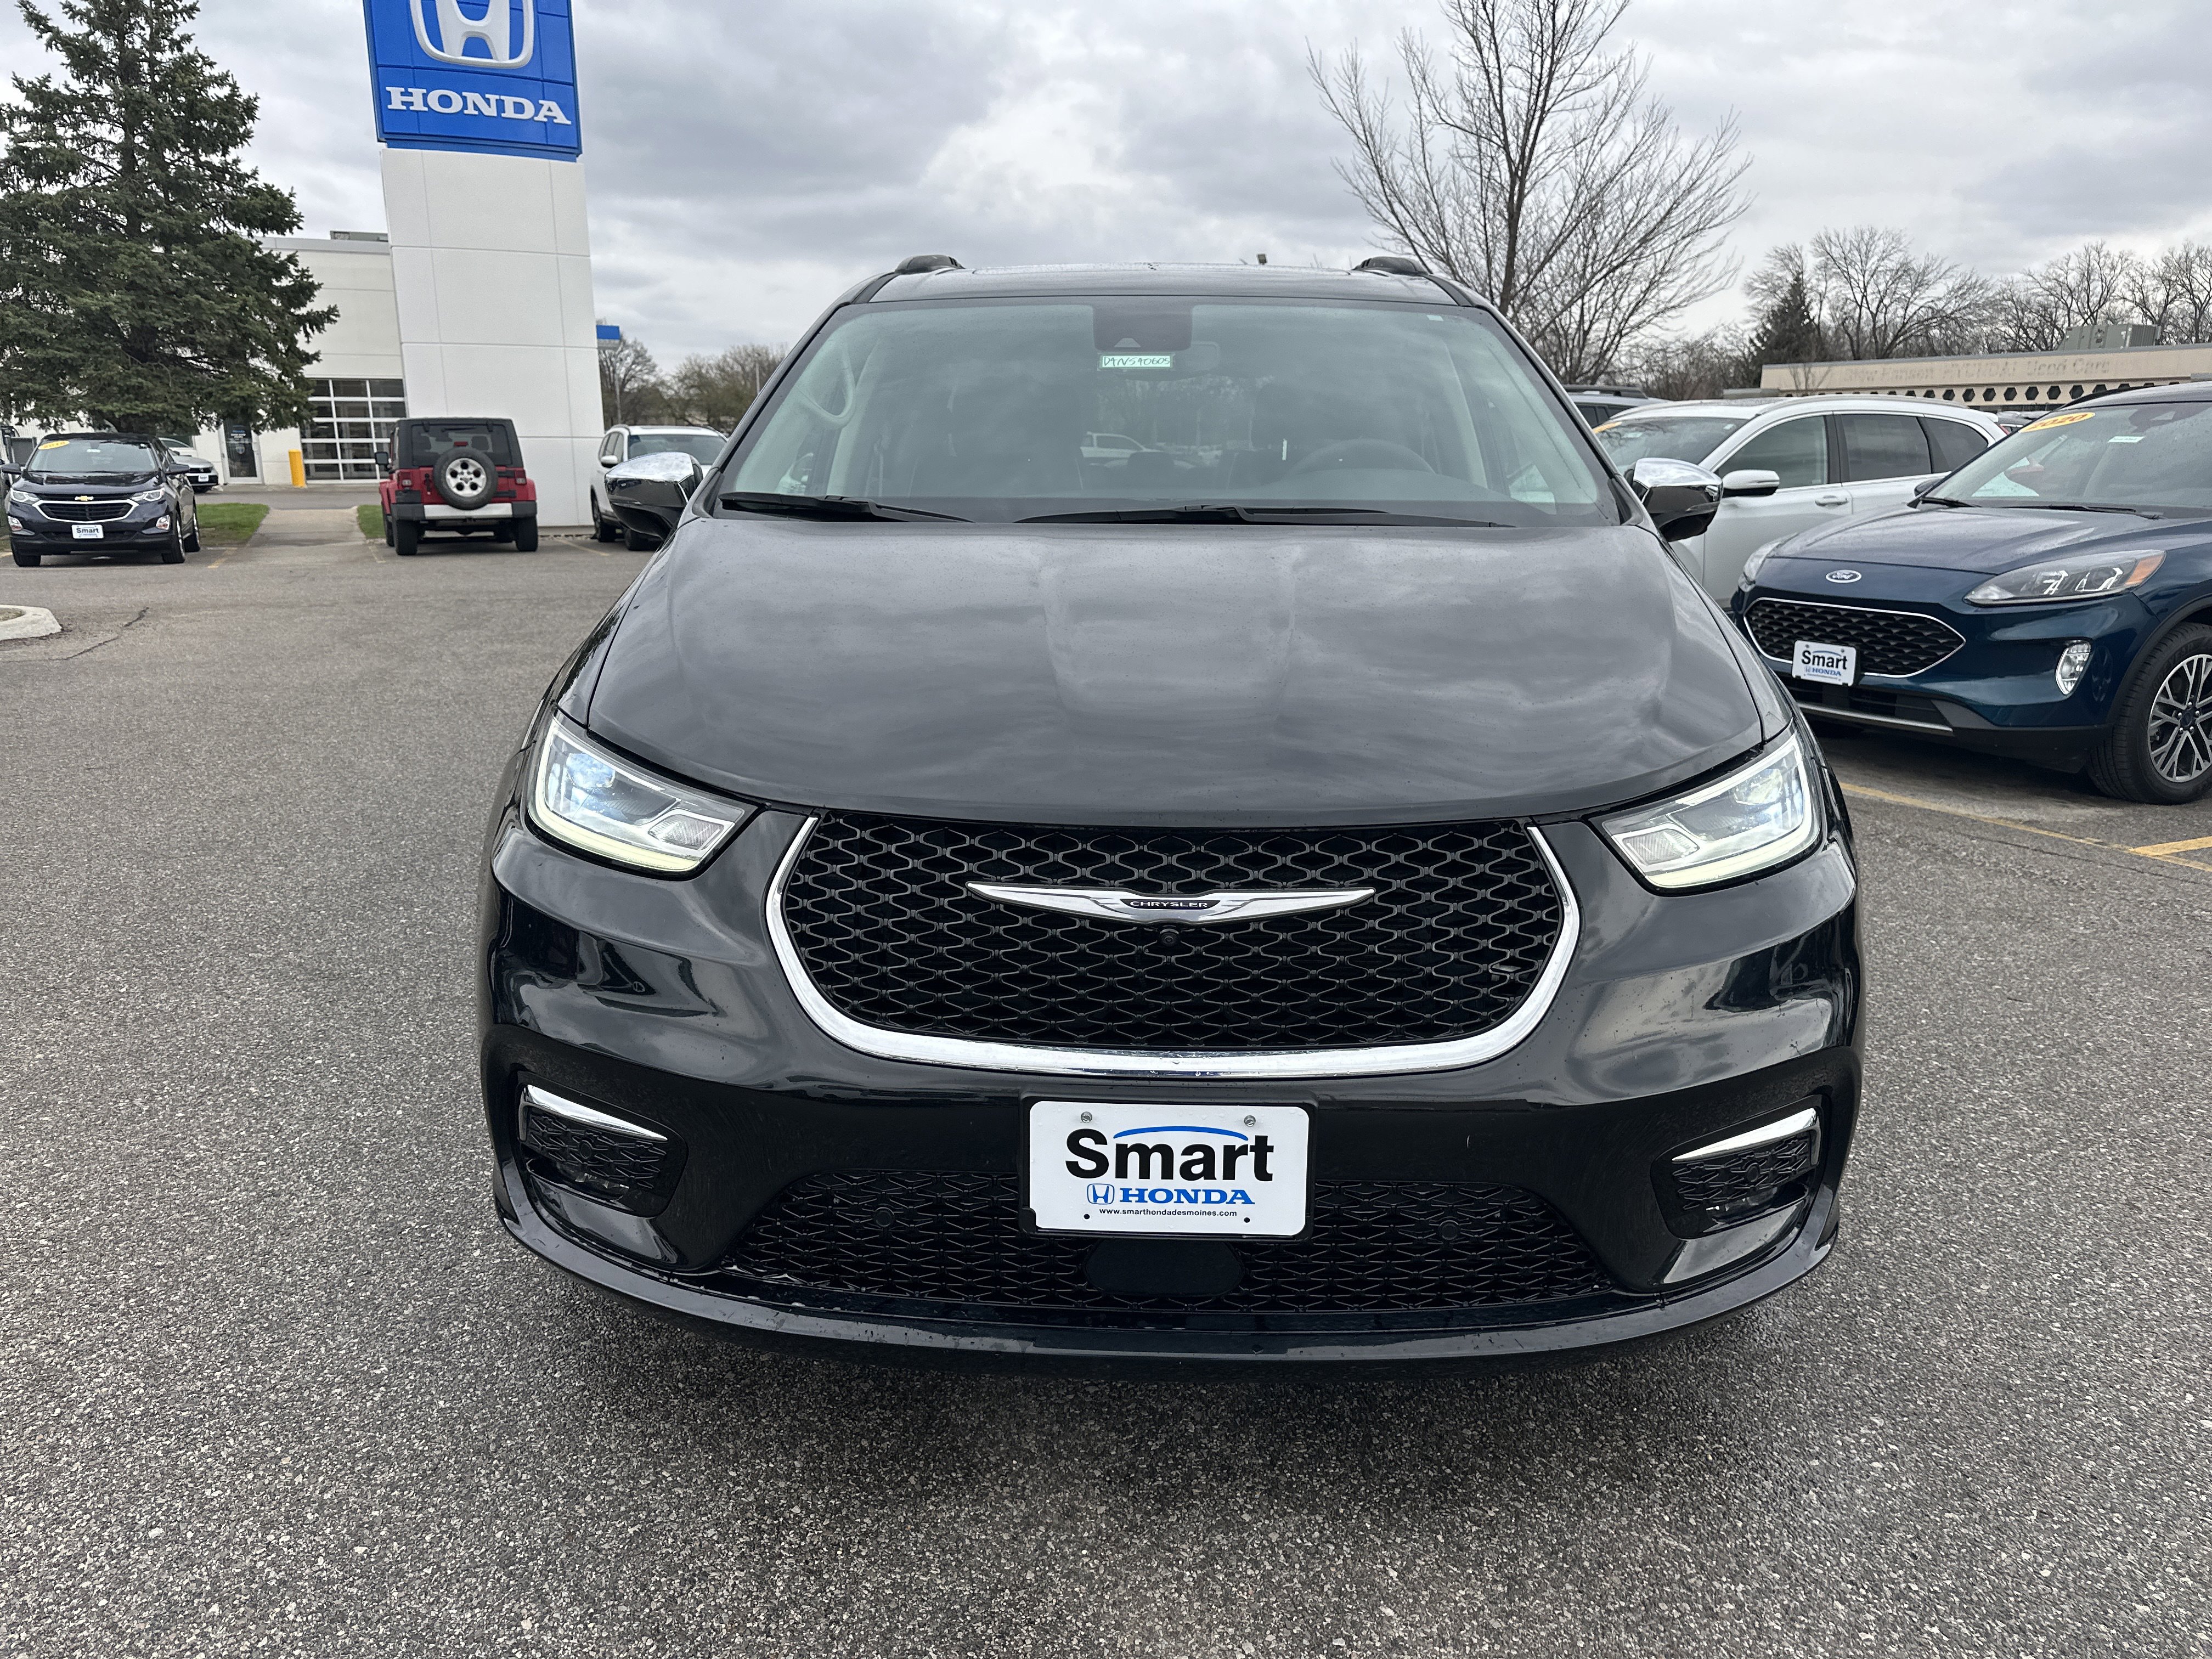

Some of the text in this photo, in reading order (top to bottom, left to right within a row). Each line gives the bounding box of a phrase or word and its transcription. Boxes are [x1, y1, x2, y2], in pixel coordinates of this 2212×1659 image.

[386, 87, 572, 125] HONDA
[2026, 414, 2088, 430] 2020
[1802, 650, 1848, 669] Smart
[1812, 667, 1842, 676] HONDA
[1065, 1128, 1274, 1182] Smart
[1119, 1188, 1255, 1205] HONDA
